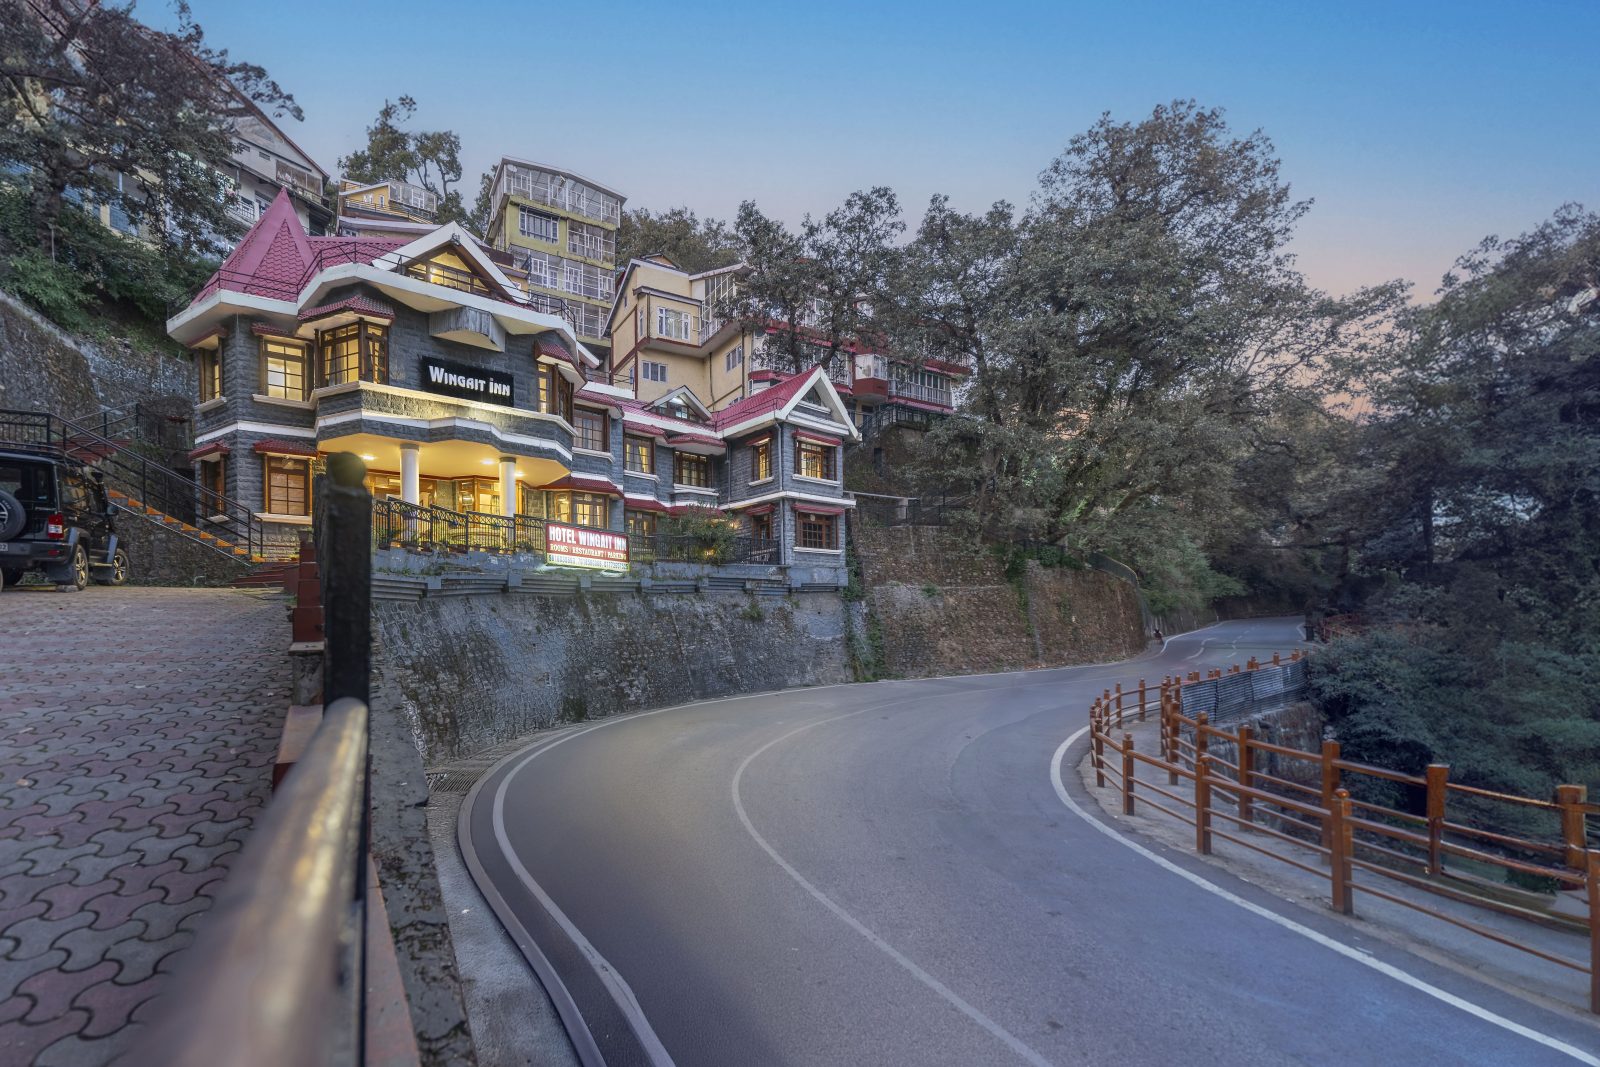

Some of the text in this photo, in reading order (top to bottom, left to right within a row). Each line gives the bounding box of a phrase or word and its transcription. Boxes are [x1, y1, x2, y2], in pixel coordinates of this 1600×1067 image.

[428, 365, 486, 392] WINGAIT
[548, 526, 627, 551] HOTEL WINGAIT INN
[550, 543, 627, 560] ROOMS RESTAURANT PARKING
